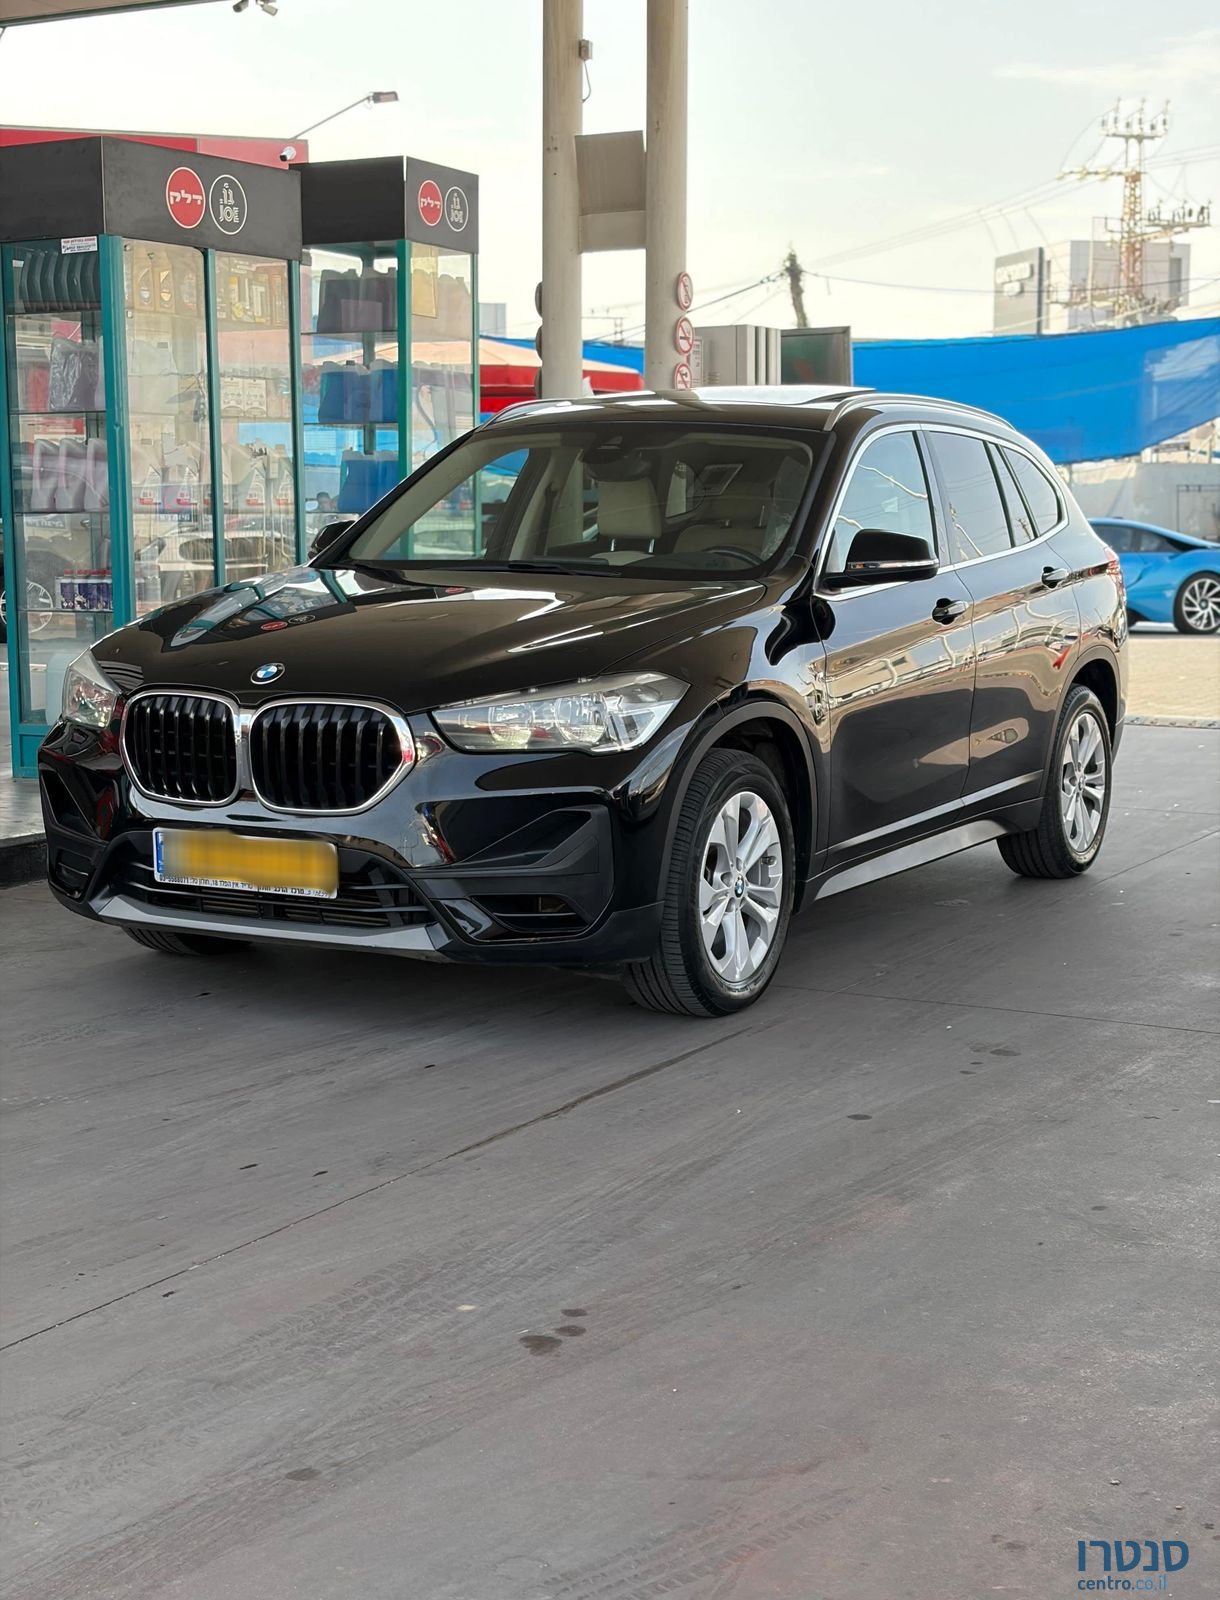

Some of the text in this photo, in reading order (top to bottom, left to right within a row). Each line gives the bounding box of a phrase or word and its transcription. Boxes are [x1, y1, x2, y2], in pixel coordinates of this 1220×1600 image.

[169, 189, 203, 205] דלק
[420, 196, 441, 209] דלק
[218, 198, 240, 223] JOE
